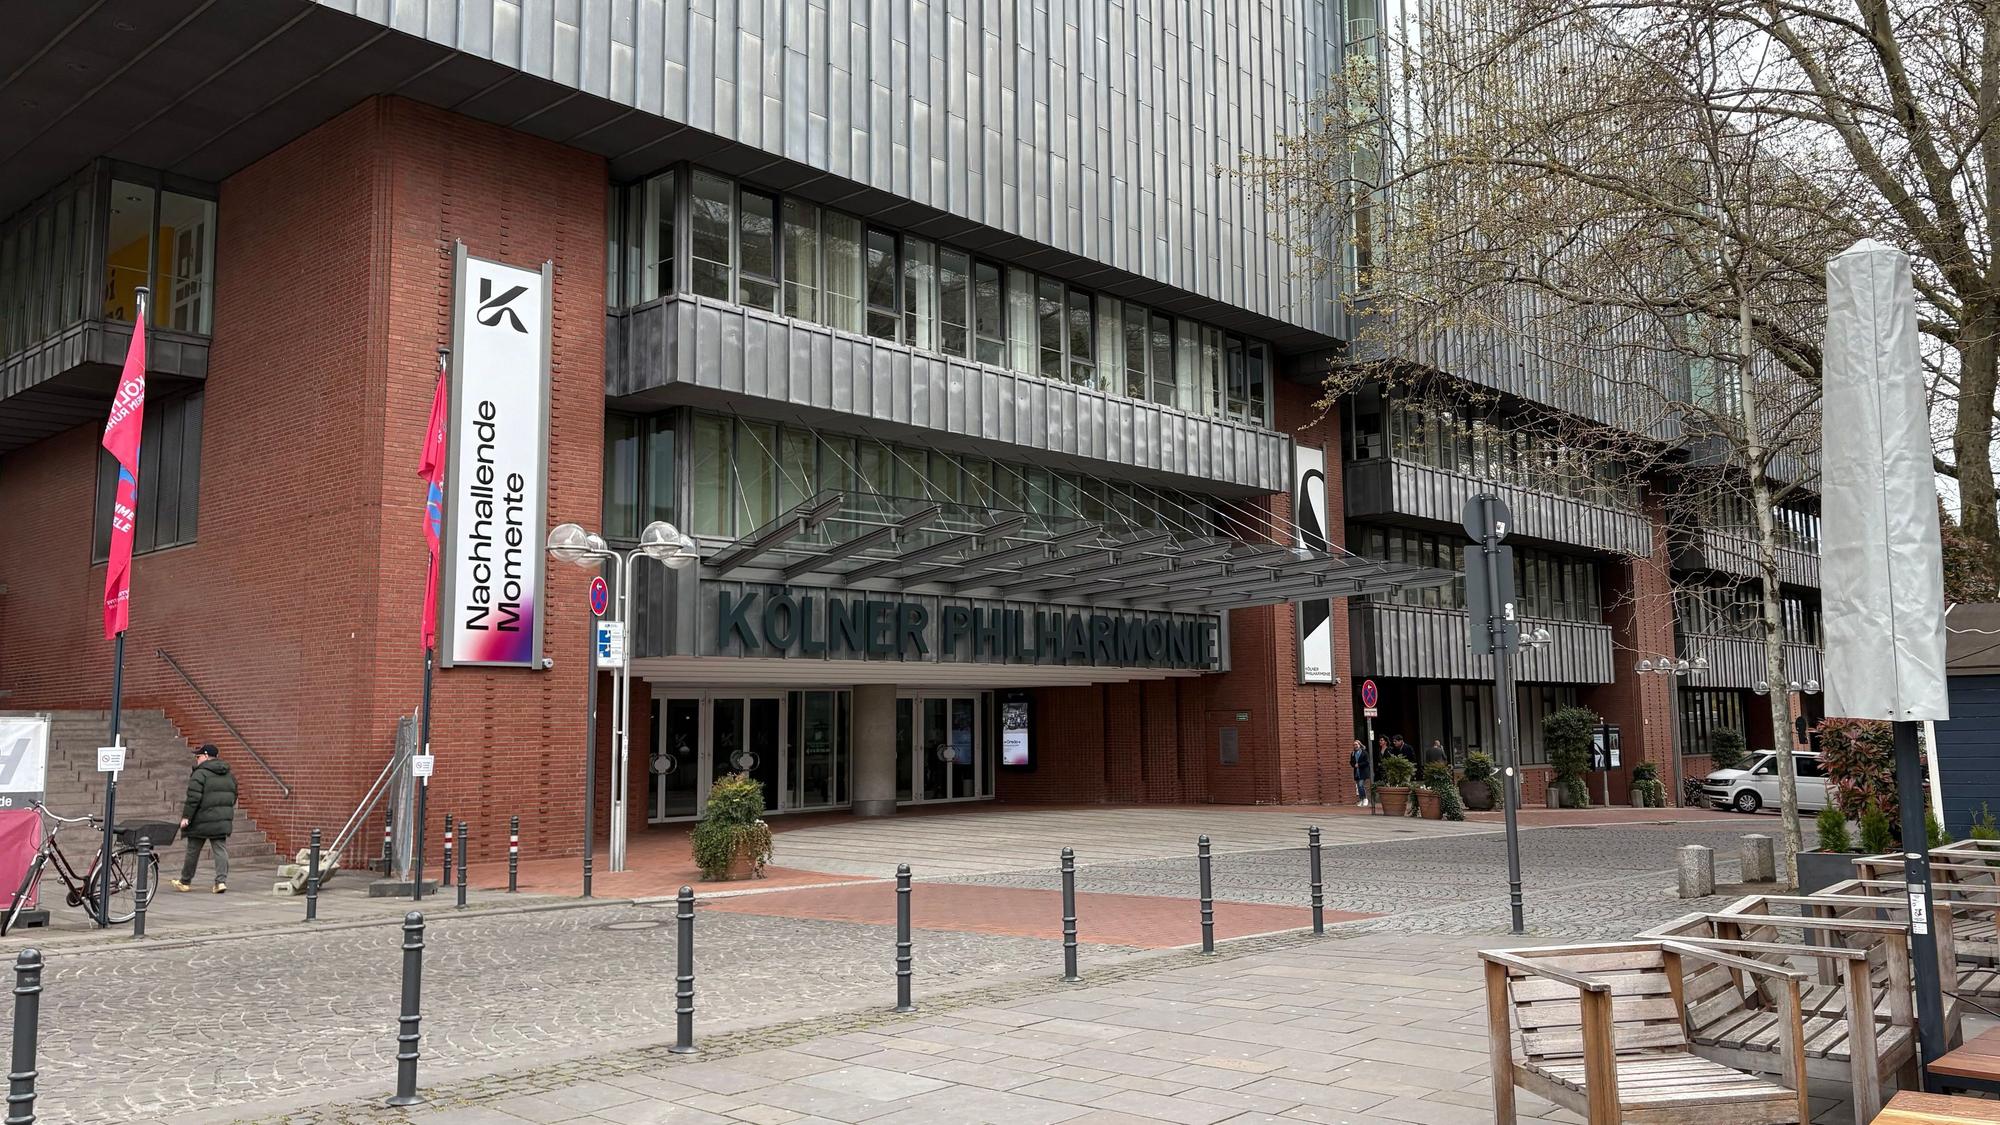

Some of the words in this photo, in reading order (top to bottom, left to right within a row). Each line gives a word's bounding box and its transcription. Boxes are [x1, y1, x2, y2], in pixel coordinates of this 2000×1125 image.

[466, 400, 496, 631] Nachhallende
[497, 472, 524, 632] Momente
[719, 586, 929, 657] KÖLNER
[943, 605, 1218, 664] PHILHARMONIE
